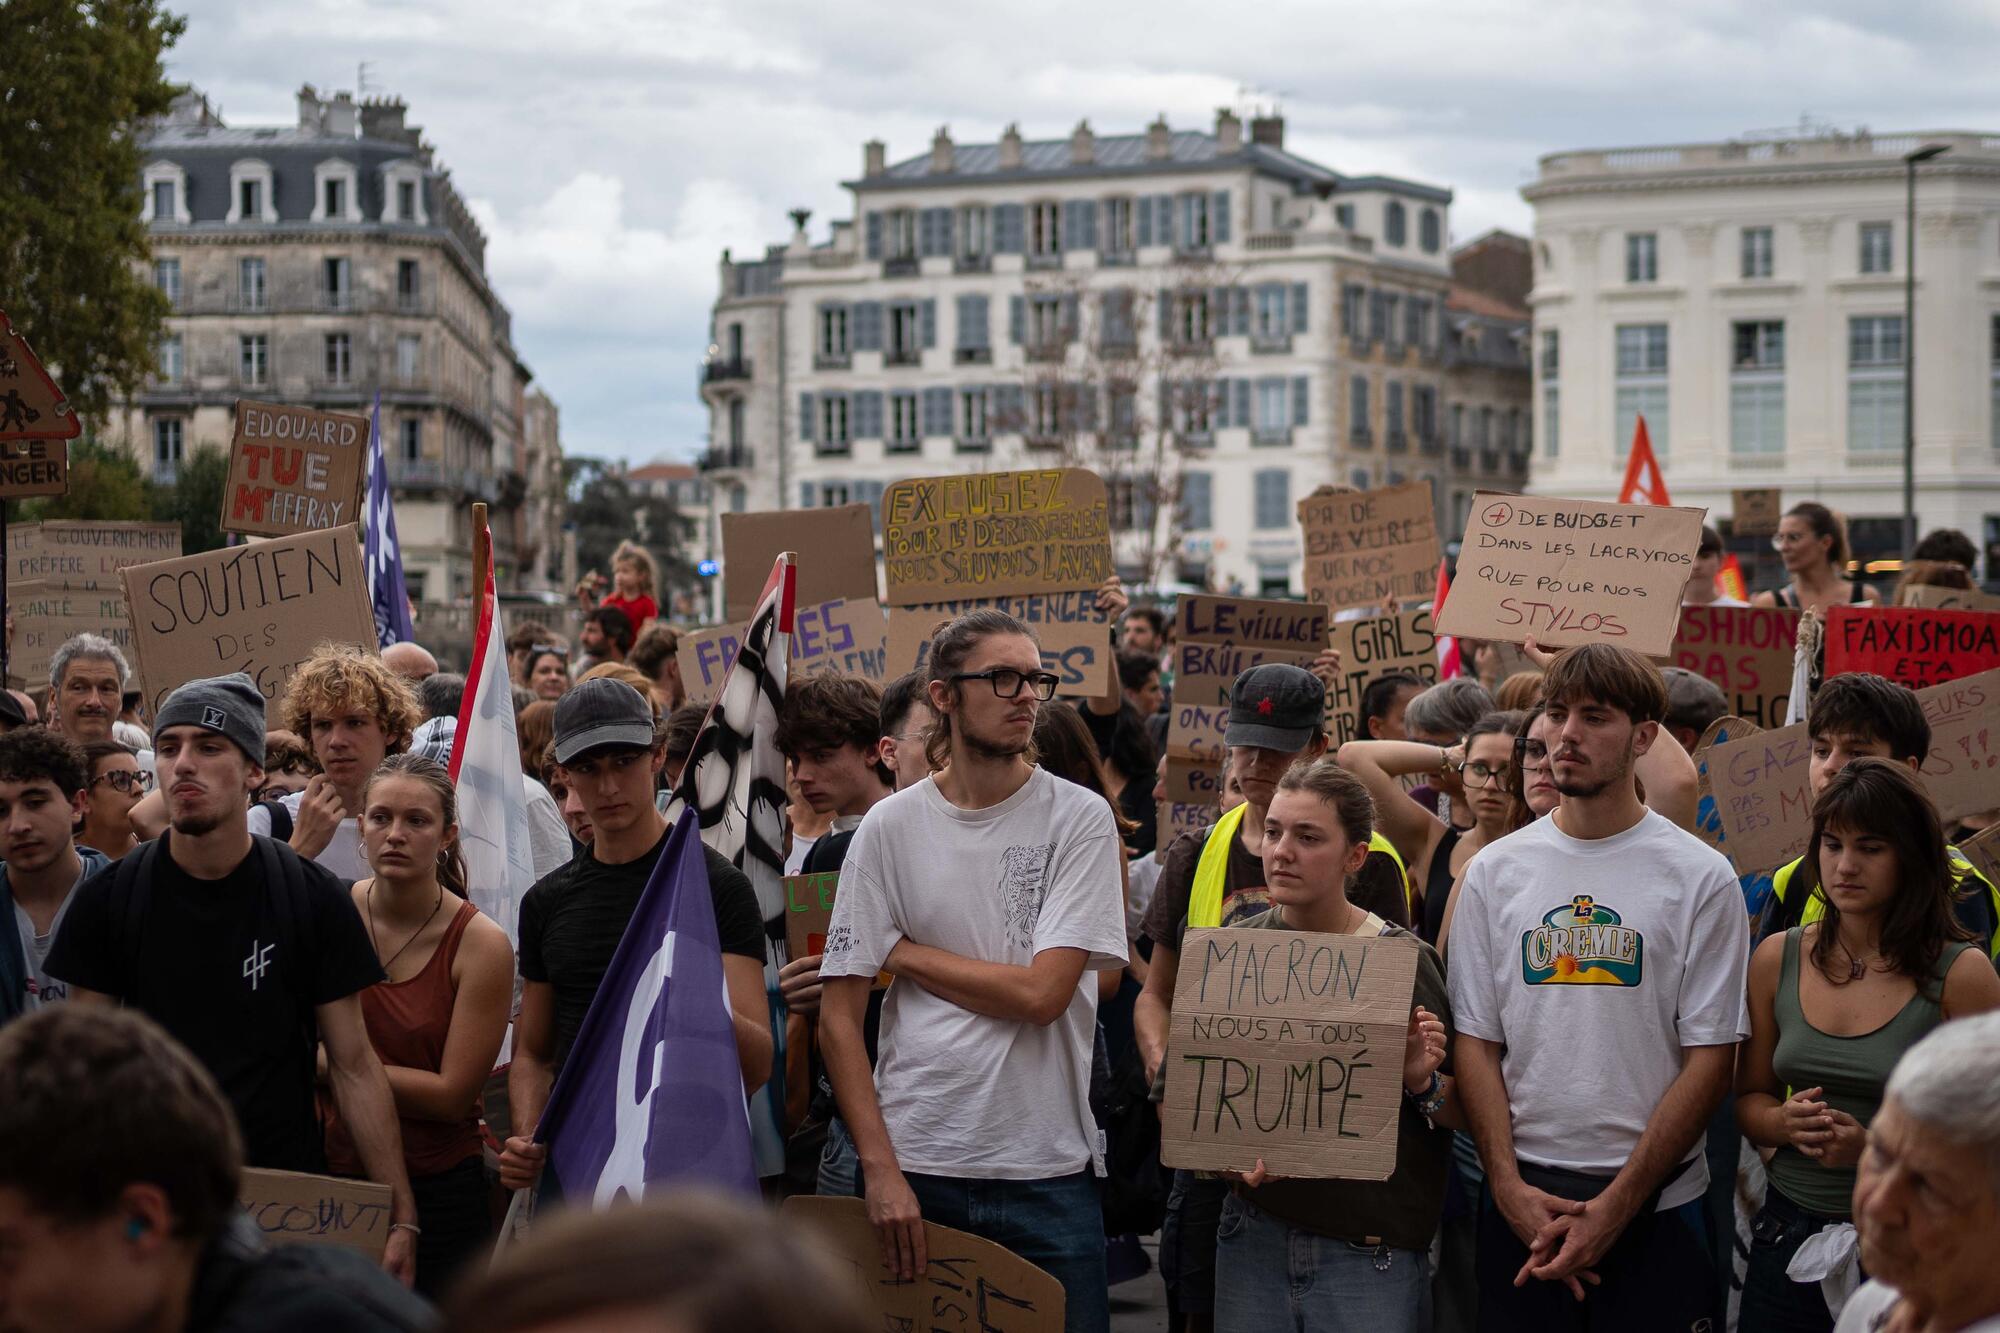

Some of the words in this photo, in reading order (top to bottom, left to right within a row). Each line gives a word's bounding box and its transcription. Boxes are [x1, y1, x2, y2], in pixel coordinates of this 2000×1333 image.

[244, 409, 357, 446] EDOUARD
[242, 444, 331, 491] TUE
[889, 472, 1066, 525] EXCUSEZ
[1350, 497, 1377, 524] DE
[1518, 509, 1549, 527] DE
[1553, 512, 1645, 529] BUDGET
[56, 528, 177, 551] GOUVERNEMENT
[886, 526, 942, 557] POUR
[950, 519, 967, 549] LE
[1478, 533, 1533, 551] DANS
[1545, 541, 1576, 556] LES
[887, 554, 937, 586] NOUS
[941, 545, 1038, 585] SAUVONS
[1478, 565, 1528, 587] QUE
[1537, 576, 1594, 593] POUR
[1603, 583, 1648, 598] NOS
[149, 538, 342, 634] SOUTIEN
[19, 596, 73, 618] SANTÉ
[1185, 599, 1237, 636] LE
[1496, 597, 1629, 637] STYLOS
[212, 623, 277, 661] DES
[1895, 657, 1954, 677] ETA
[1728, 738, 1813, 788] GAZ
[1736, 812, 1771, 834] LES
[1573, 905, 1593, 917] La
[1528, 924, 1637, 971] CREME
[1200, 938, 1367, 1011] MACRON
[1193, 1014, 1268, 1041] NOUS
[1278, 1020, 1295, 1041] A
[1304, 1024, 1367, 1045] TOUS
[1184, 1048, 1372, 1138] TRUMPÉ
